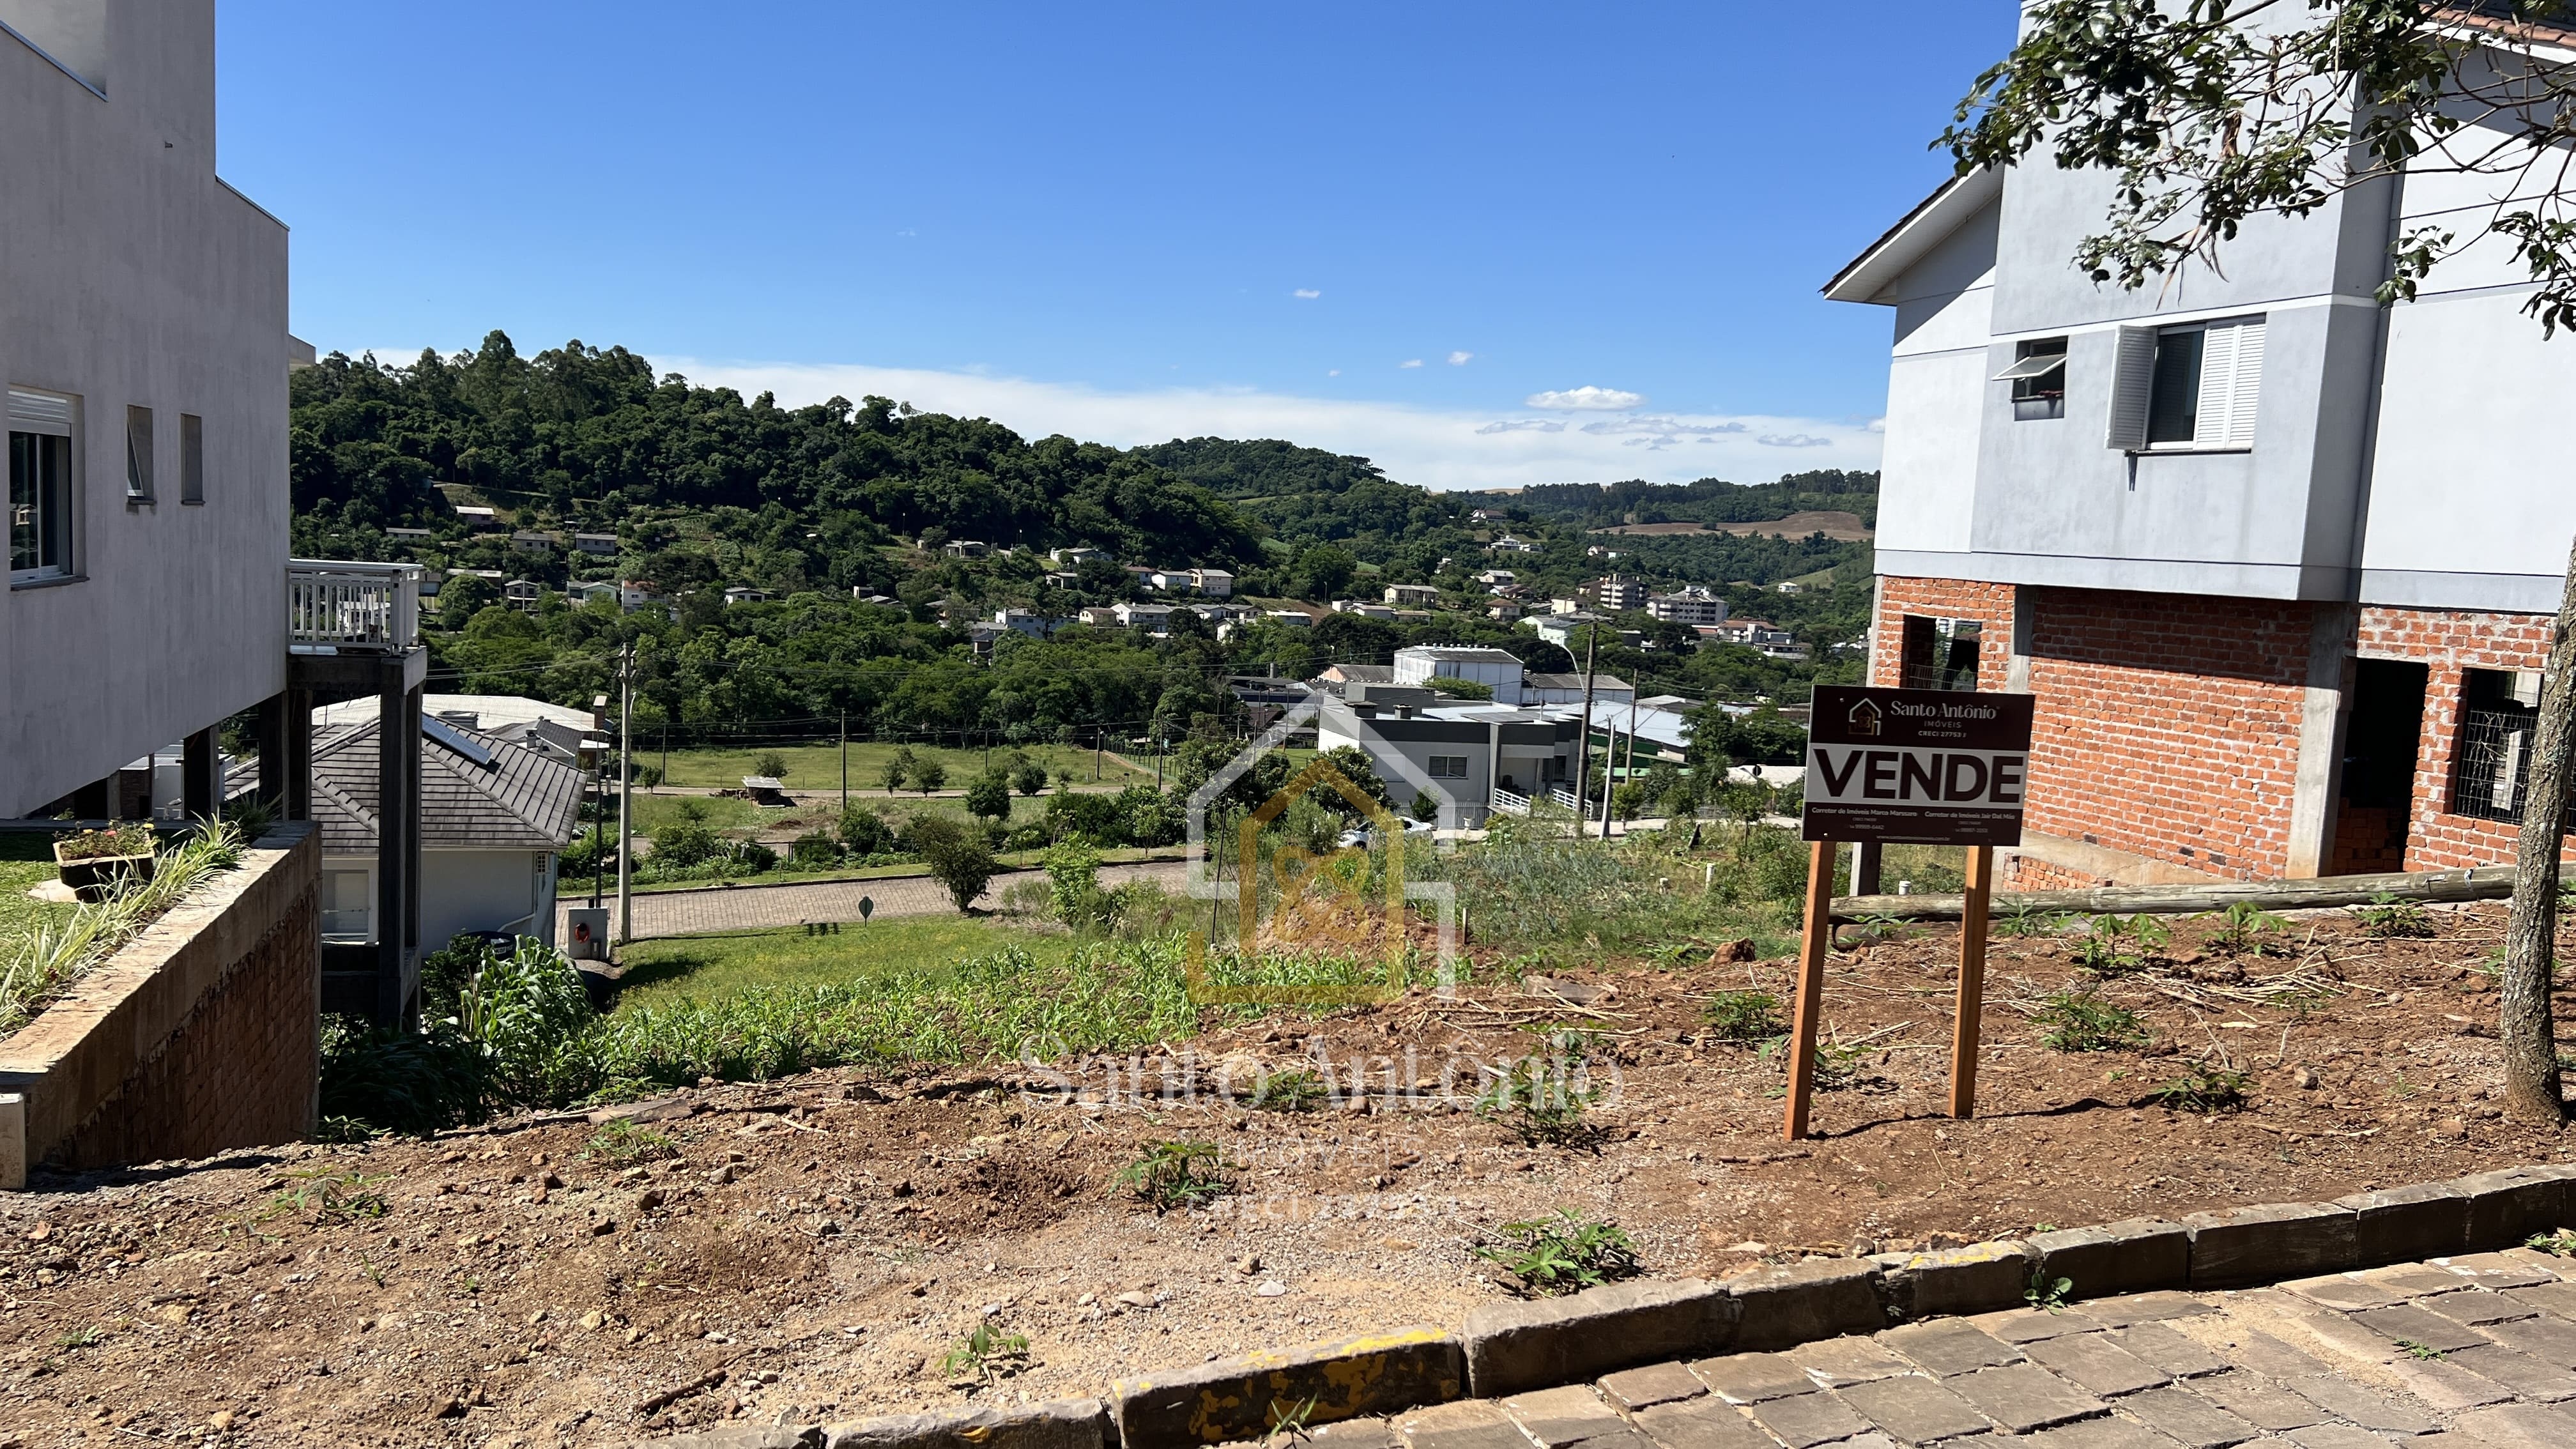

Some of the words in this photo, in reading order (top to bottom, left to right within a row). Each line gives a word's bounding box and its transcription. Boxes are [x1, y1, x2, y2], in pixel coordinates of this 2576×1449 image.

[1890, 700, 1936, 717] Santo
[1937, 703, 1997, 719] Antônio
[1924, 719, 1962, 728] IMÓVEIS
[1813, 748, 2024, 804] VENDE
